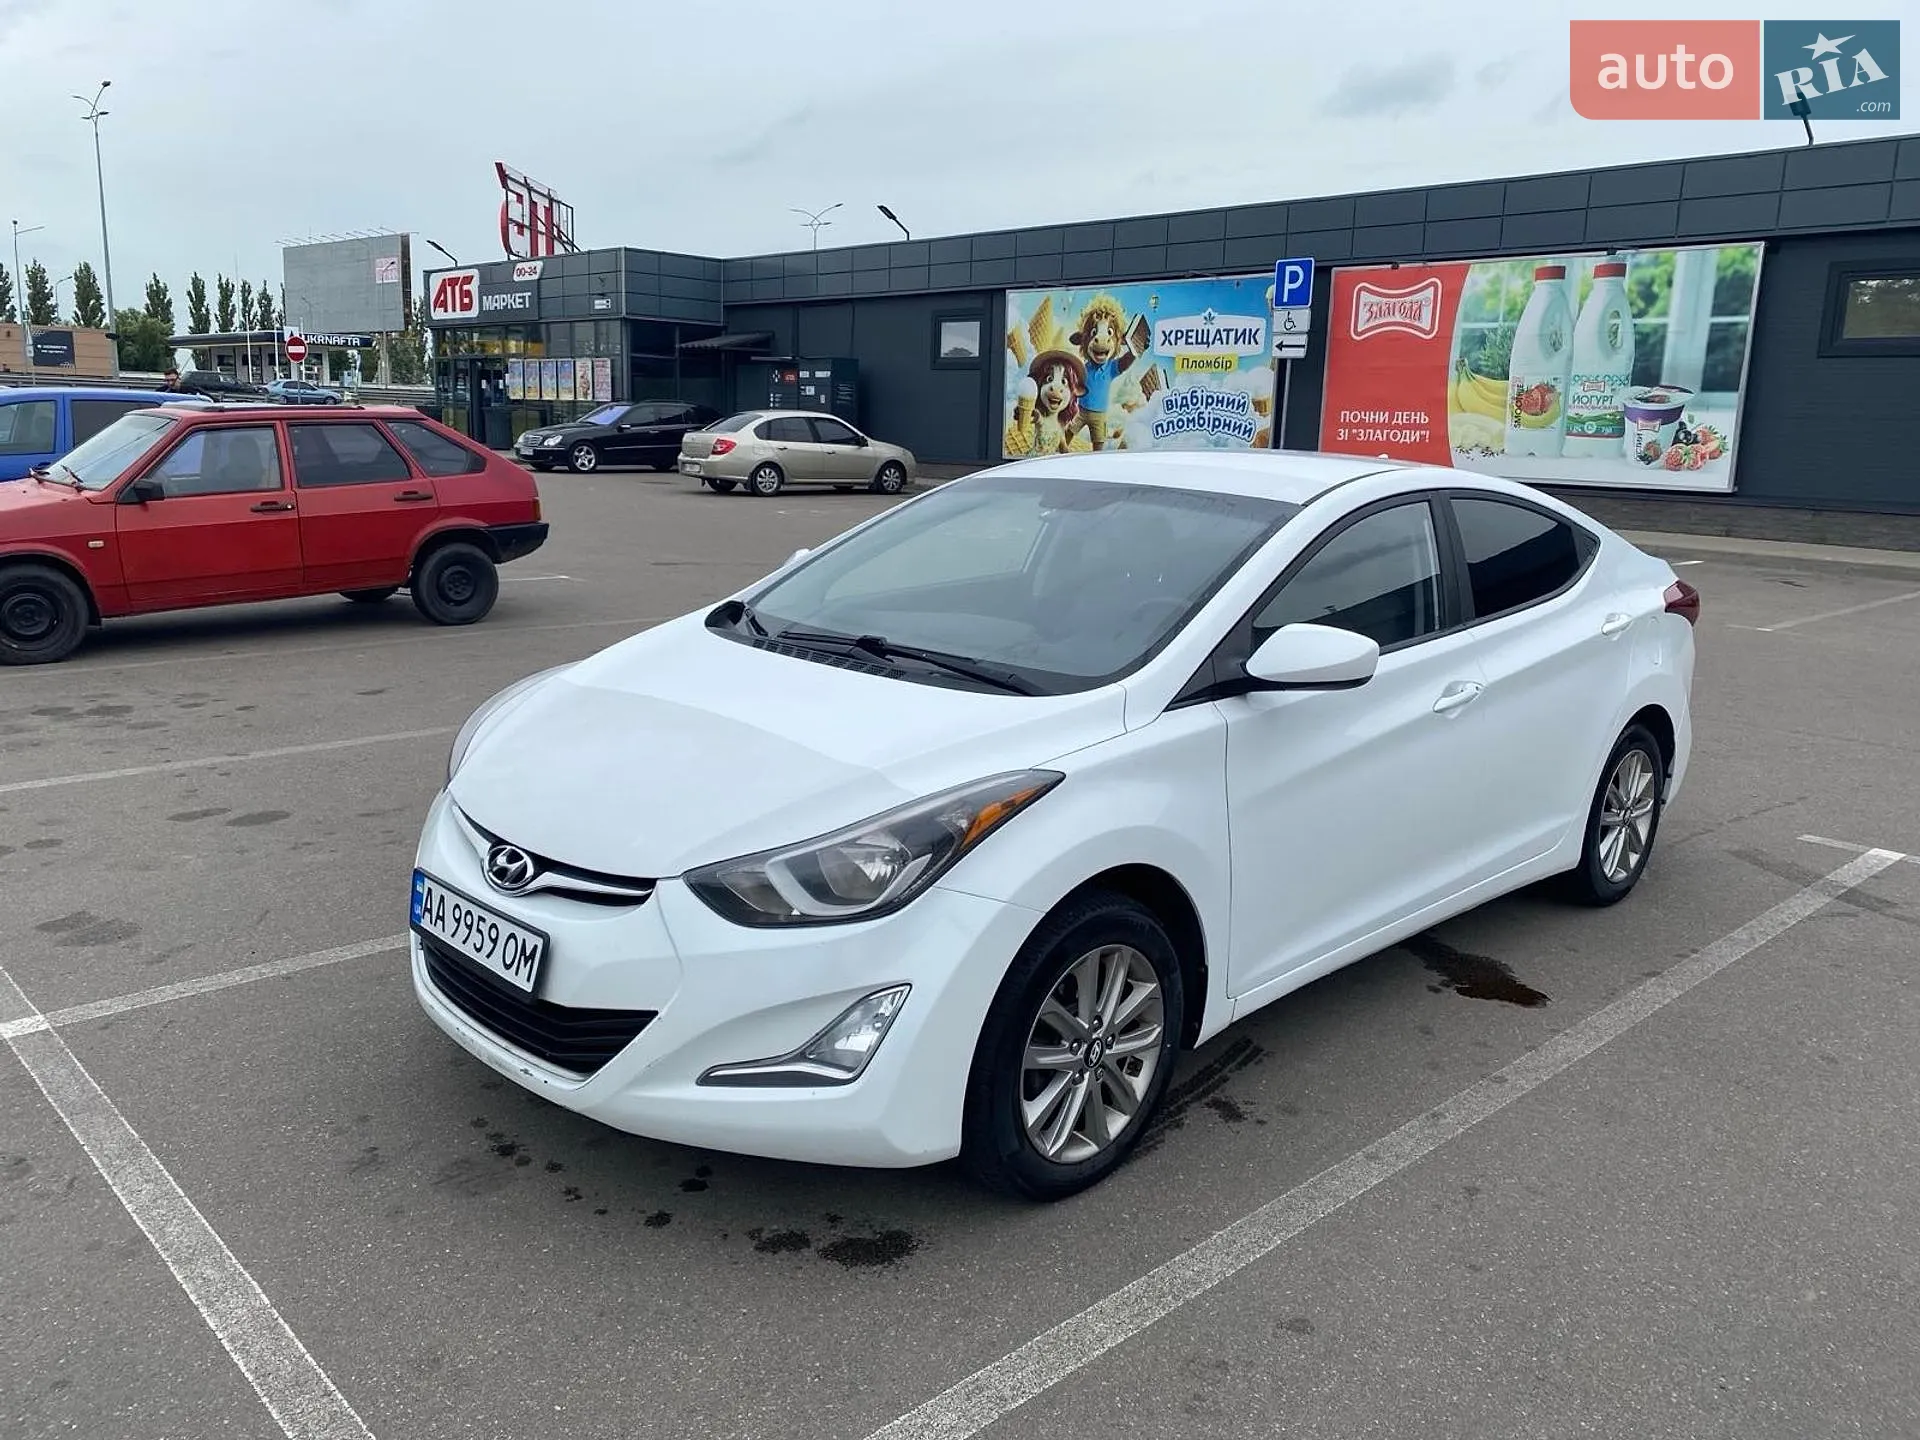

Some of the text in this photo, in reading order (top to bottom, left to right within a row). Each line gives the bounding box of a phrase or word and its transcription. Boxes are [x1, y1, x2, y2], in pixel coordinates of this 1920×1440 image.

[515, 266, 538, 277] 00-24
[432, 275, 532, 314] АТБ МАРКЕТ
[1283, 265, 1304, 303] P
[1160, 327, 1261, 349] ХРЕЩАТИК
[1180, 356, 1233, 372] Пломбір
[1165, 389, 1248, 413] відбірний
[1572, 392, 1614, 406] ЙОГУРТ
[1153, 411, 1256, 439] пломбірний
[1340, 410, 1430, 426] ПОЧНИ ДЕНЬ
[1336, 428, 1430, 444] ЗІ "ЗЛАГОДИ"!
[422, 886, 539, 983] AA 9959 OM
